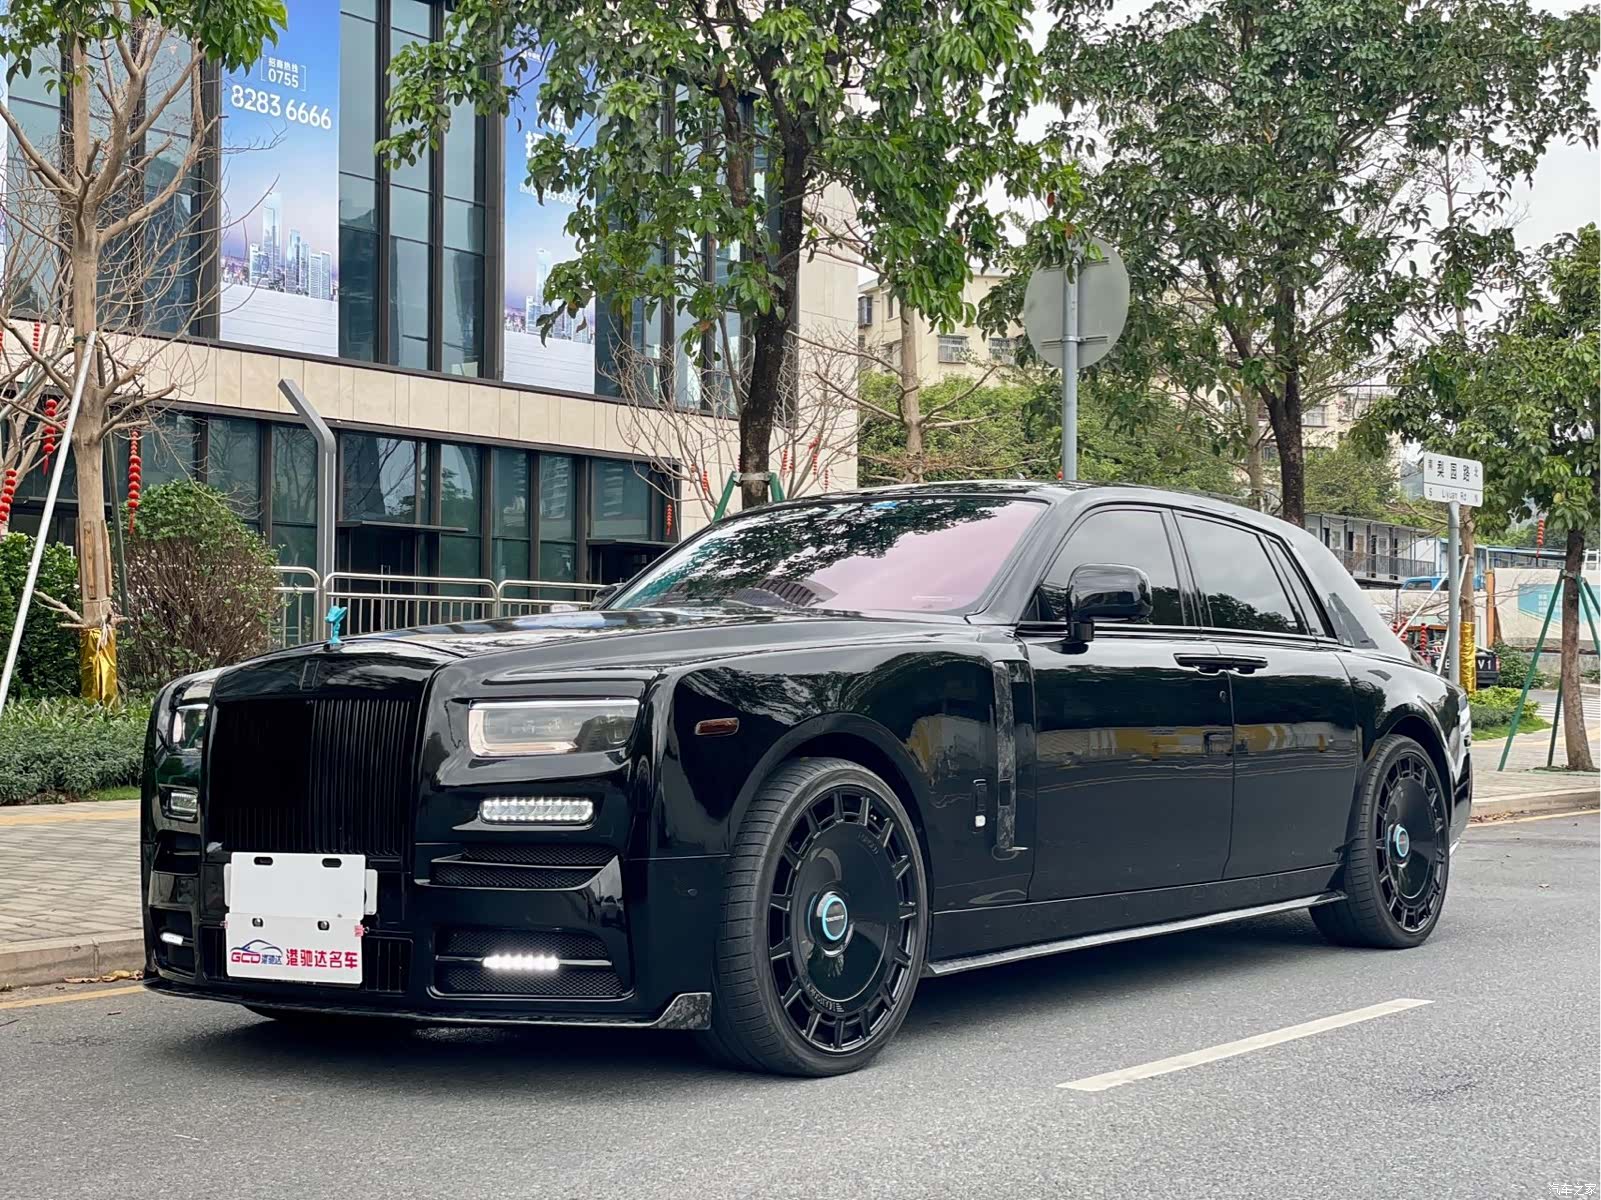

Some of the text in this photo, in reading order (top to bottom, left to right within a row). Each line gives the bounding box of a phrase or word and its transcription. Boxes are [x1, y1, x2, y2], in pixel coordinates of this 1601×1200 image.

[268, 57, 299, 74] 招商热线
[268, 68, 299, 88] 0755
[231, 84, 332, 129] 8283 6666
[231, 952, 260, 963] GCD
[286, 948, 358, 969] 港驰达名车
